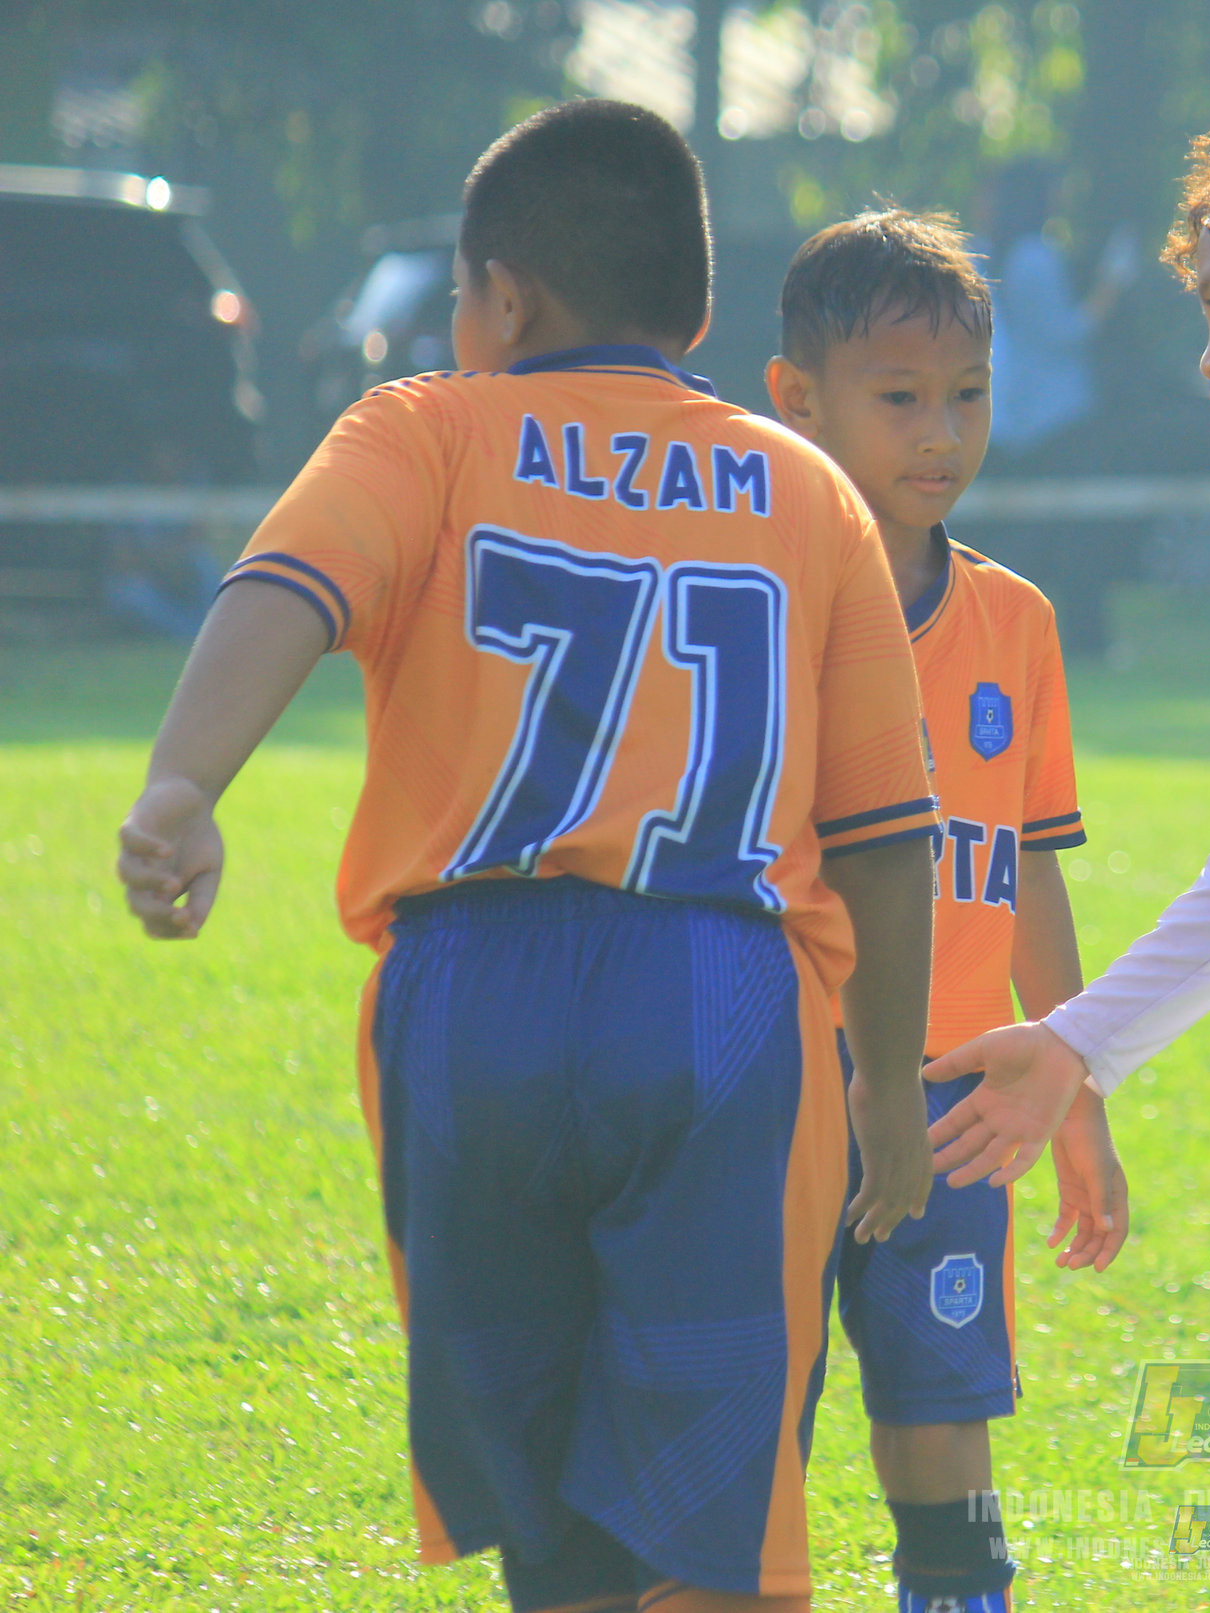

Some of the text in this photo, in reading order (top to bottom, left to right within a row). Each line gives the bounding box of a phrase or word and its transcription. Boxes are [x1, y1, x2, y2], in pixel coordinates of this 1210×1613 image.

[513, 413, 771, 518] ALZAM
[438, 522, 788, 914] 71
[931, 816, 1019, 915] TA
